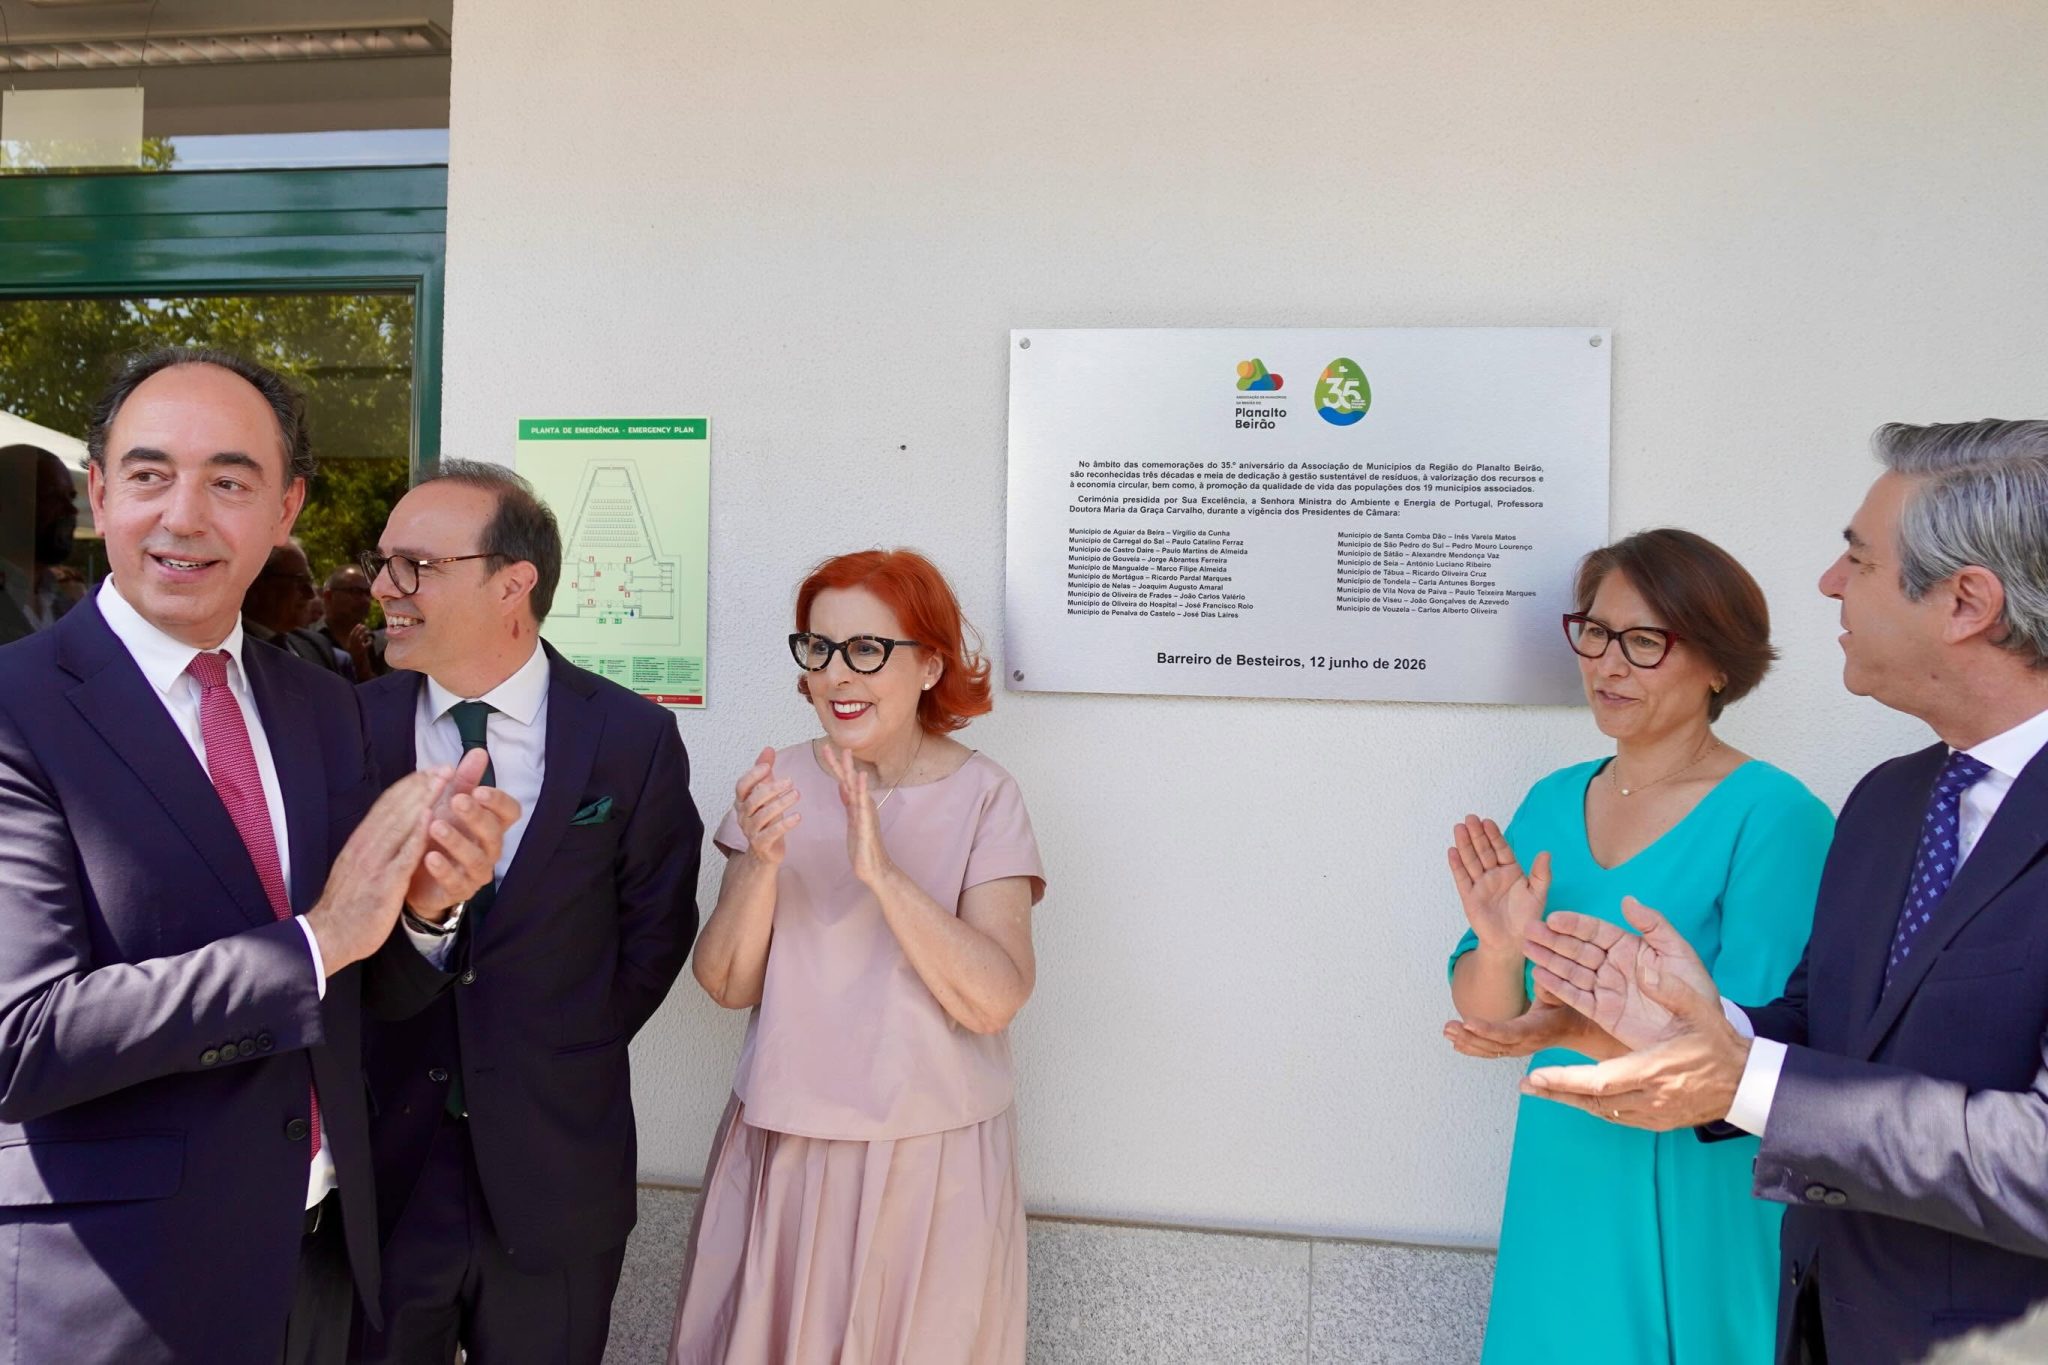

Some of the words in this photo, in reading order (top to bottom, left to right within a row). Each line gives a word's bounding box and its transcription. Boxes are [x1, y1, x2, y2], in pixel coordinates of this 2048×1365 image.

[1323, 377, 1362, 409] 35
[1235, 407, 1287, 417] Planalto
[1235, 418, 1276, 429] Beirão
[1141, 461, 1204, 470] comemorações
[1238, 461, 1285, 469] aniversário
[1300, 462, 1349, 471] Associação
[1366, 462, 1412, 471] Municípios
[1428, 463, 1459, 472] Região
[1476, 463, 1511, 471] Planalto
[1513, 464, 1544, 472] Beirão,
[1237, 471, 1280, 481] dedicação
[1289, 472, 1317, 481] gestão
[1319, 472, 1367, 480] sustentável
[1381, 473, 1420, 481] resíduos,
[1430, 473, 1478, 482] valorização
[1206, 481, 1248, 490] promoção
[1262, 482, 1302, 491] qualidade
[1354, 483, 1403, 492] populações
[1435, 484, 1481, 493] municípios
[1122, 496, 1160, 504] presidida
[1201, 496, 1247, 504] Excelência,
[1298, 497, 1332, 505] Ministra
[1403, 498, 1436, 508] Energia
[1454, 499, 1493, 508] Portugal,
[1497, 499, 1543, 507] Professora
[1139, 506, 1164, 515] Graça
[1166, 506, 1204, 514] Carvalho,
[1247, 507, 1282, 516] vigência
[1365, 508, 1400, 516] Câmara:
[1113, 528, 1135, 536] Aguiar
[1172, 529, 1196, 537] Virgílio
[1067, 572, 1100, 580] Município
[1111, 573, 1144, 581] Mortágua
[1336, 577, 1371, 585] Município
[1470, 579, 1495, 587] Borges
[1067, 581, 1100, 589] Município
[1168, 583, 1197, 591] Augusto
[1157, 652, 1211, 664] Barreiro
[1215, 654, 1232, 665] de
[1236, 654, 1304, 668] Besteiros,
[1310, 656, 1325, 667] 12
[1328, 656, 1368, 671] junho
[1372, 658, 1389, 669] de
[1393, 658, 1426, 670] 2026
